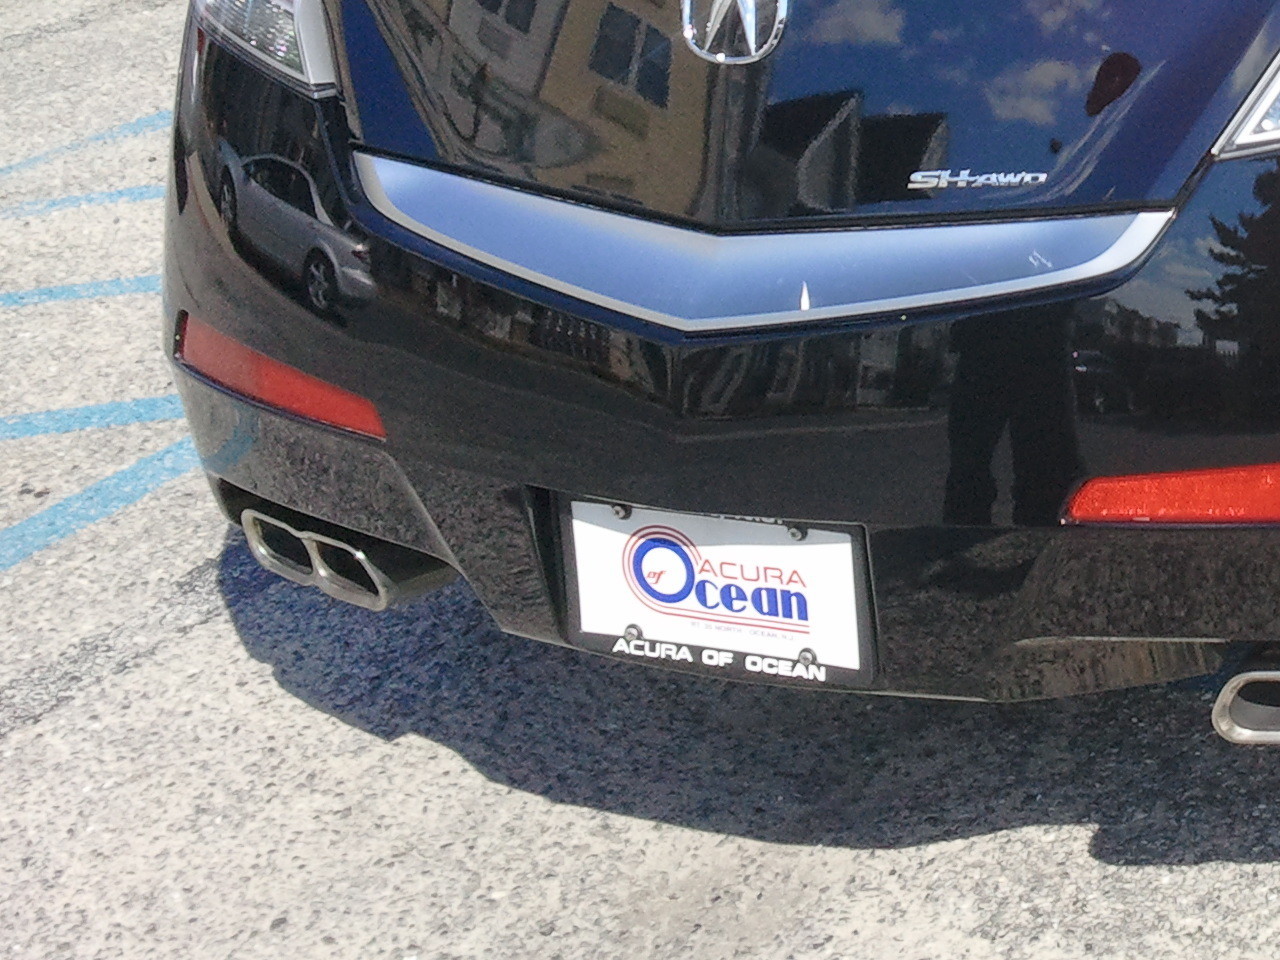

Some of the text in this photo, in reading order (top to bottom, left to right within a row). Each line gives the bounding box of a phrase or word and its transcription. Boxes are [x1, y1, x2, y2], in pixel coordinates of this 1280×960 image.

[632, 537, 809, 621] of Ocean
[698, 559, 807, 588] ACURA
[612, 638, 827, 682] ACURA OF OCEAN
